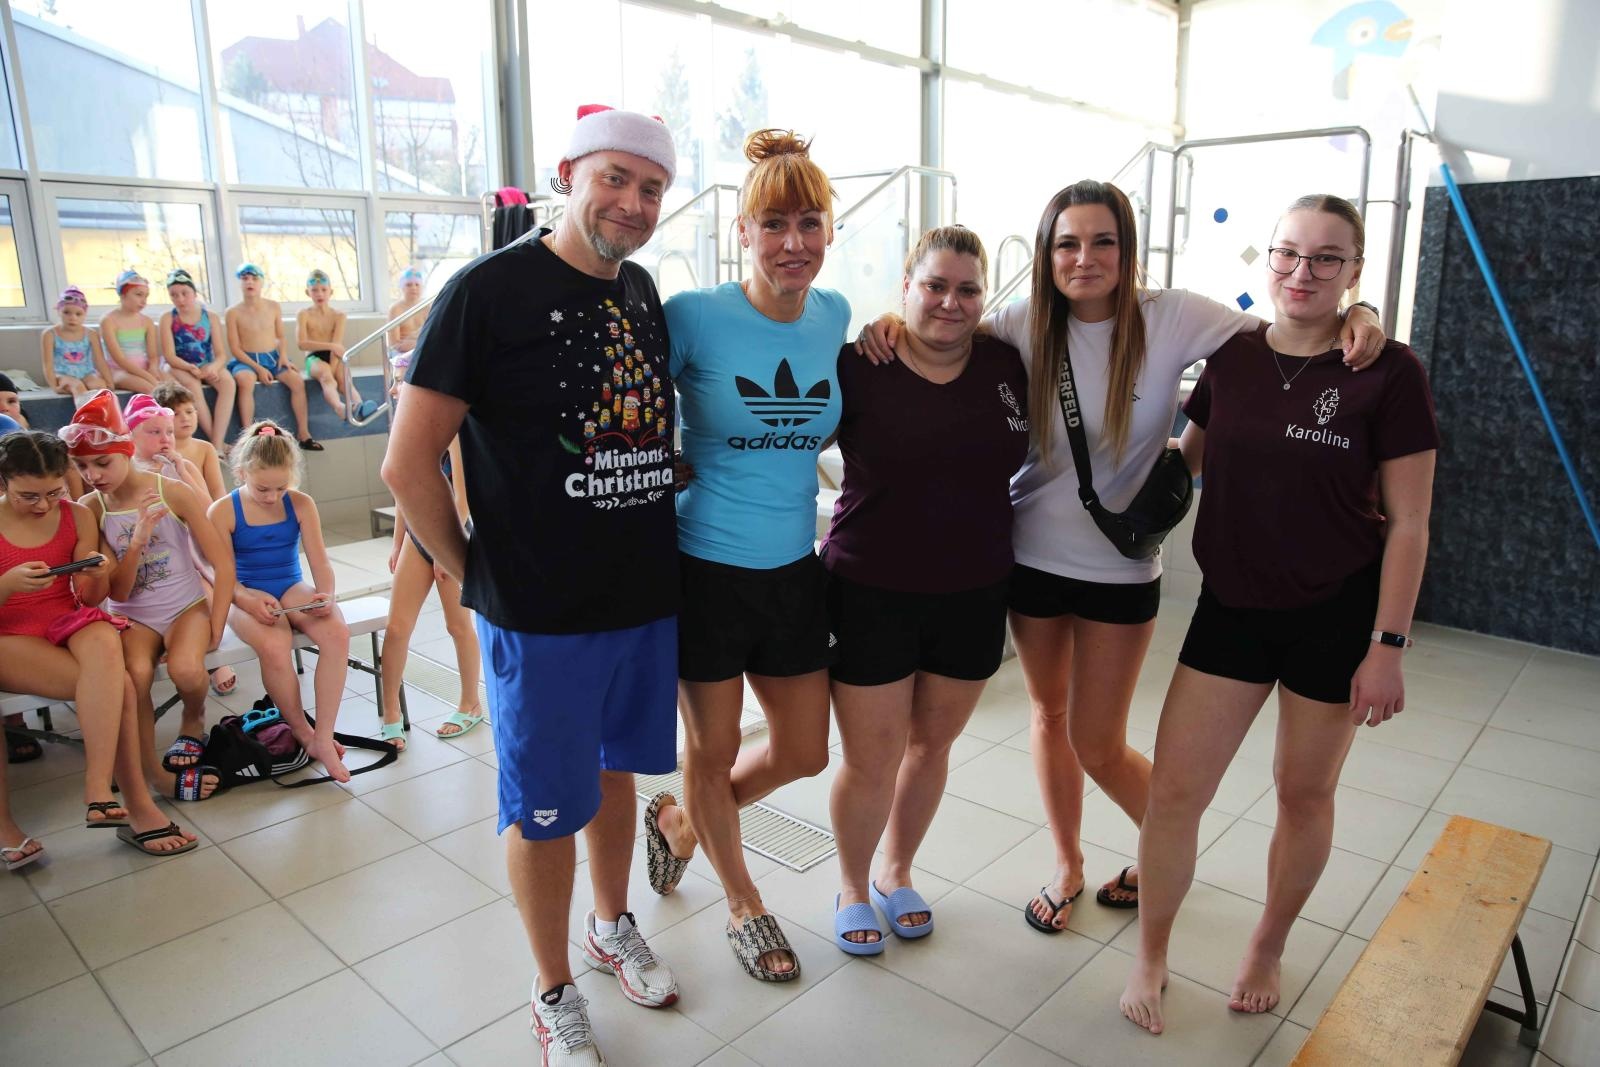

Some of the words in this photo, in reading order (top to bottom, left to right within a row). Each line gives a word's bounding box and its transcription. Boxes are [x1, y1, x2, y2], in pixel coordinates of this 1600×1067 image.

[727, 431, 821, 450] adidas
[1285, 423, 1350, 449] Karolina
[594, 448, 663, 471] Minions
[565, 467, 673, 498] Christma
[533, 808, 558, 817] arena
